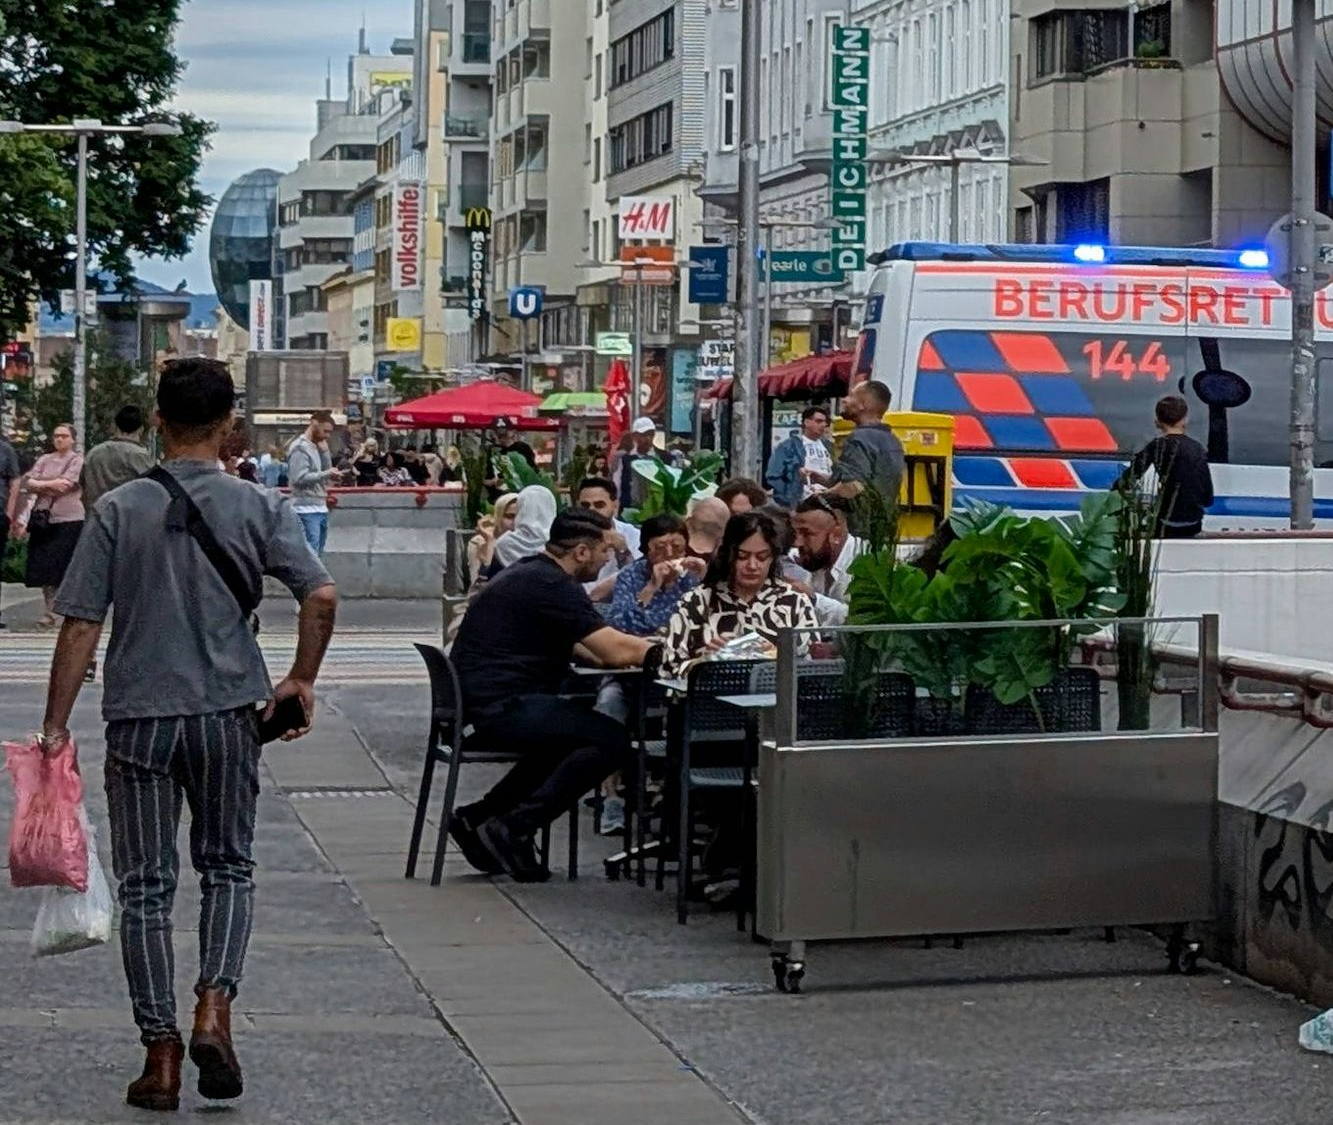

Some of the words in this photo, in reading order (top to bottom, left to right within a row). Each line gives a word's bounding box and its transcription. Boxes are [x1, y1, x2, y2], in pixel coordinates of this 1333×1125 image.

[838, 29, 863, 270] DEICHMANN
[623, 202, 671, 233] H&M
[1082, 339, 1171, 383] 144
